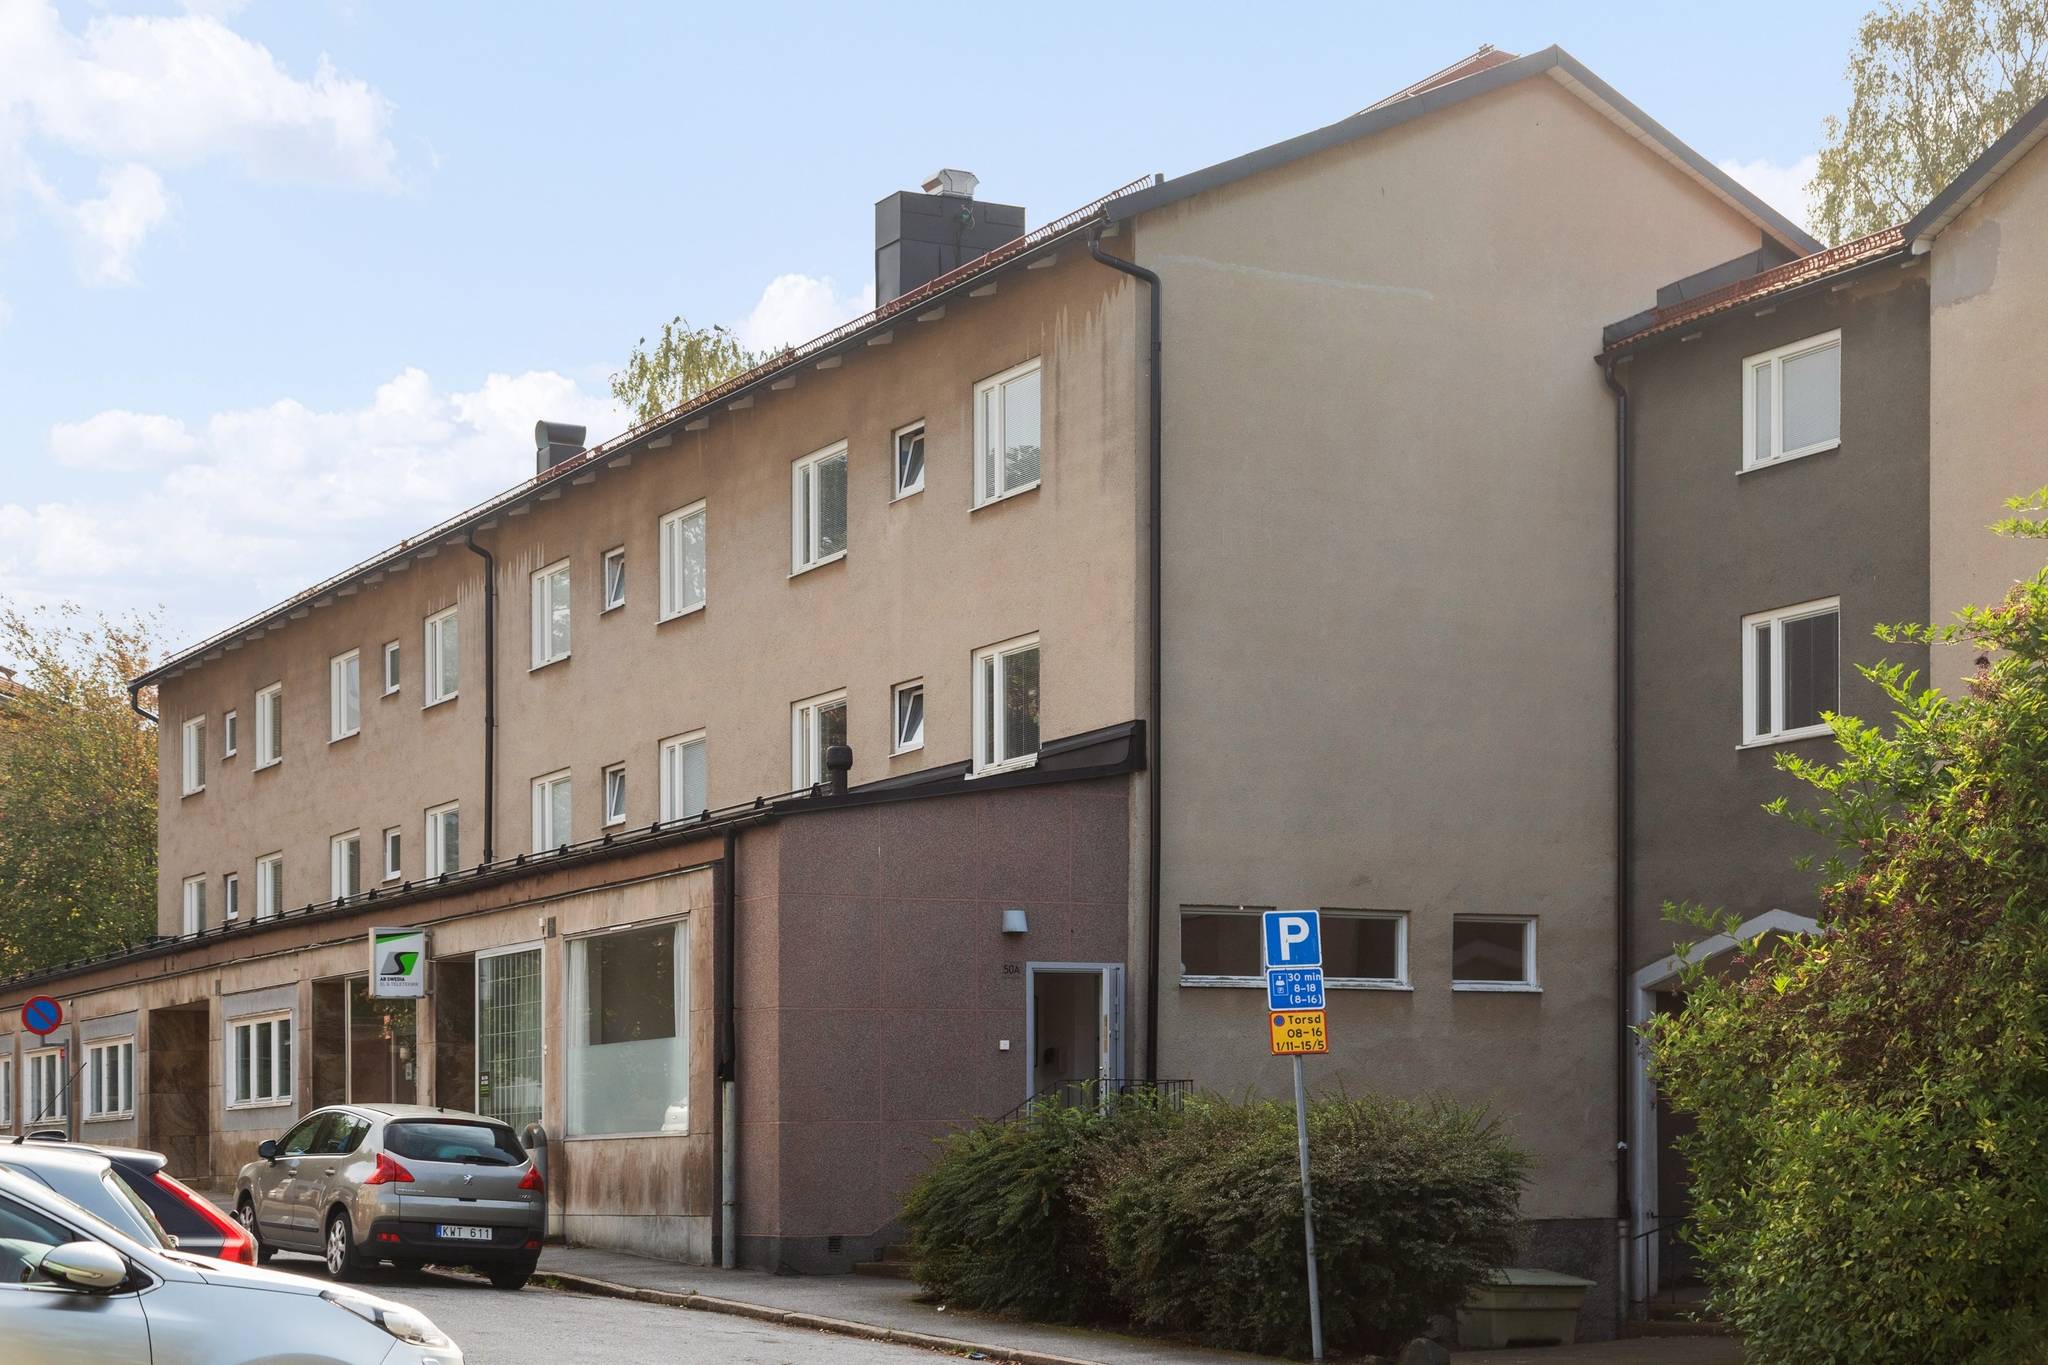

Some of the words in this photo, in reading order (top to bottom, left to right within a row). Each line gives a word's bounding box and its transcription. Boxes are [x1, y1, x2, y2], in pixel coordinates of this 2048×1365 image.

[1279, 916, 1309, 960] P
[1003, 964, 1020, 975] 50A
[1287, 973, 1301, 981] 30
[1304, 972, 1321, 981] min
[1294, 984, 1316, 992] 8-18
[1290, 994, 1322, 1004] (8-16)
[1288, 1015, 1321, 1025] Torsd
[1276, 1041, 1325, 1051] 1/11-15/5
[442, 1227, 462, 1237] KWT
[470, 1229, 489, 1239] 611
